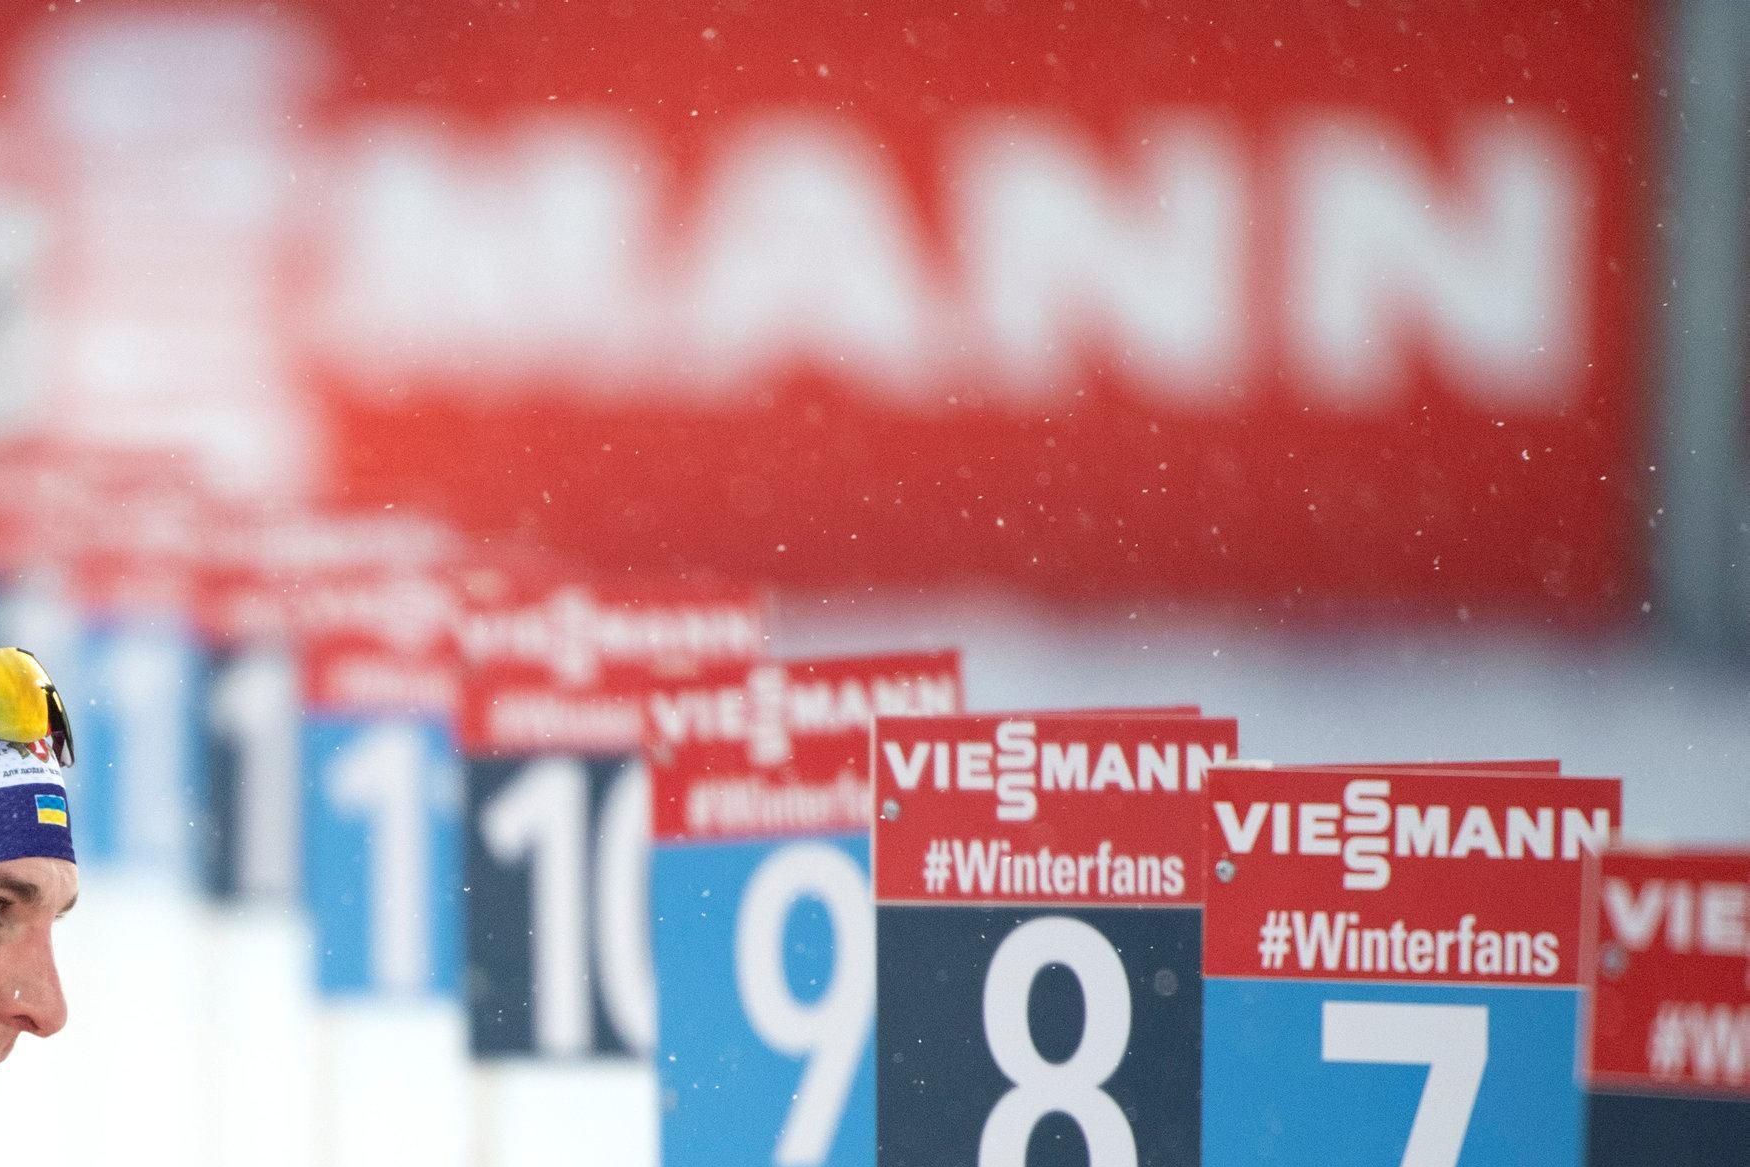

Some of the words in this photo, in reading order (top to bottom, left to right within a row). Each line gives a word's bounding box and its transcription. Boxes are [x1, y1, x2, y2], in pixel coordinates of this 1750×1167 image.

[883, 720, 1229, 822] VIESSMANN
[923, 839, 1186, 897] #Winterfans
[1213, 779, 1611, 891] VIESSMANN
[1258, 909, 1561, 978] #Winterfans
